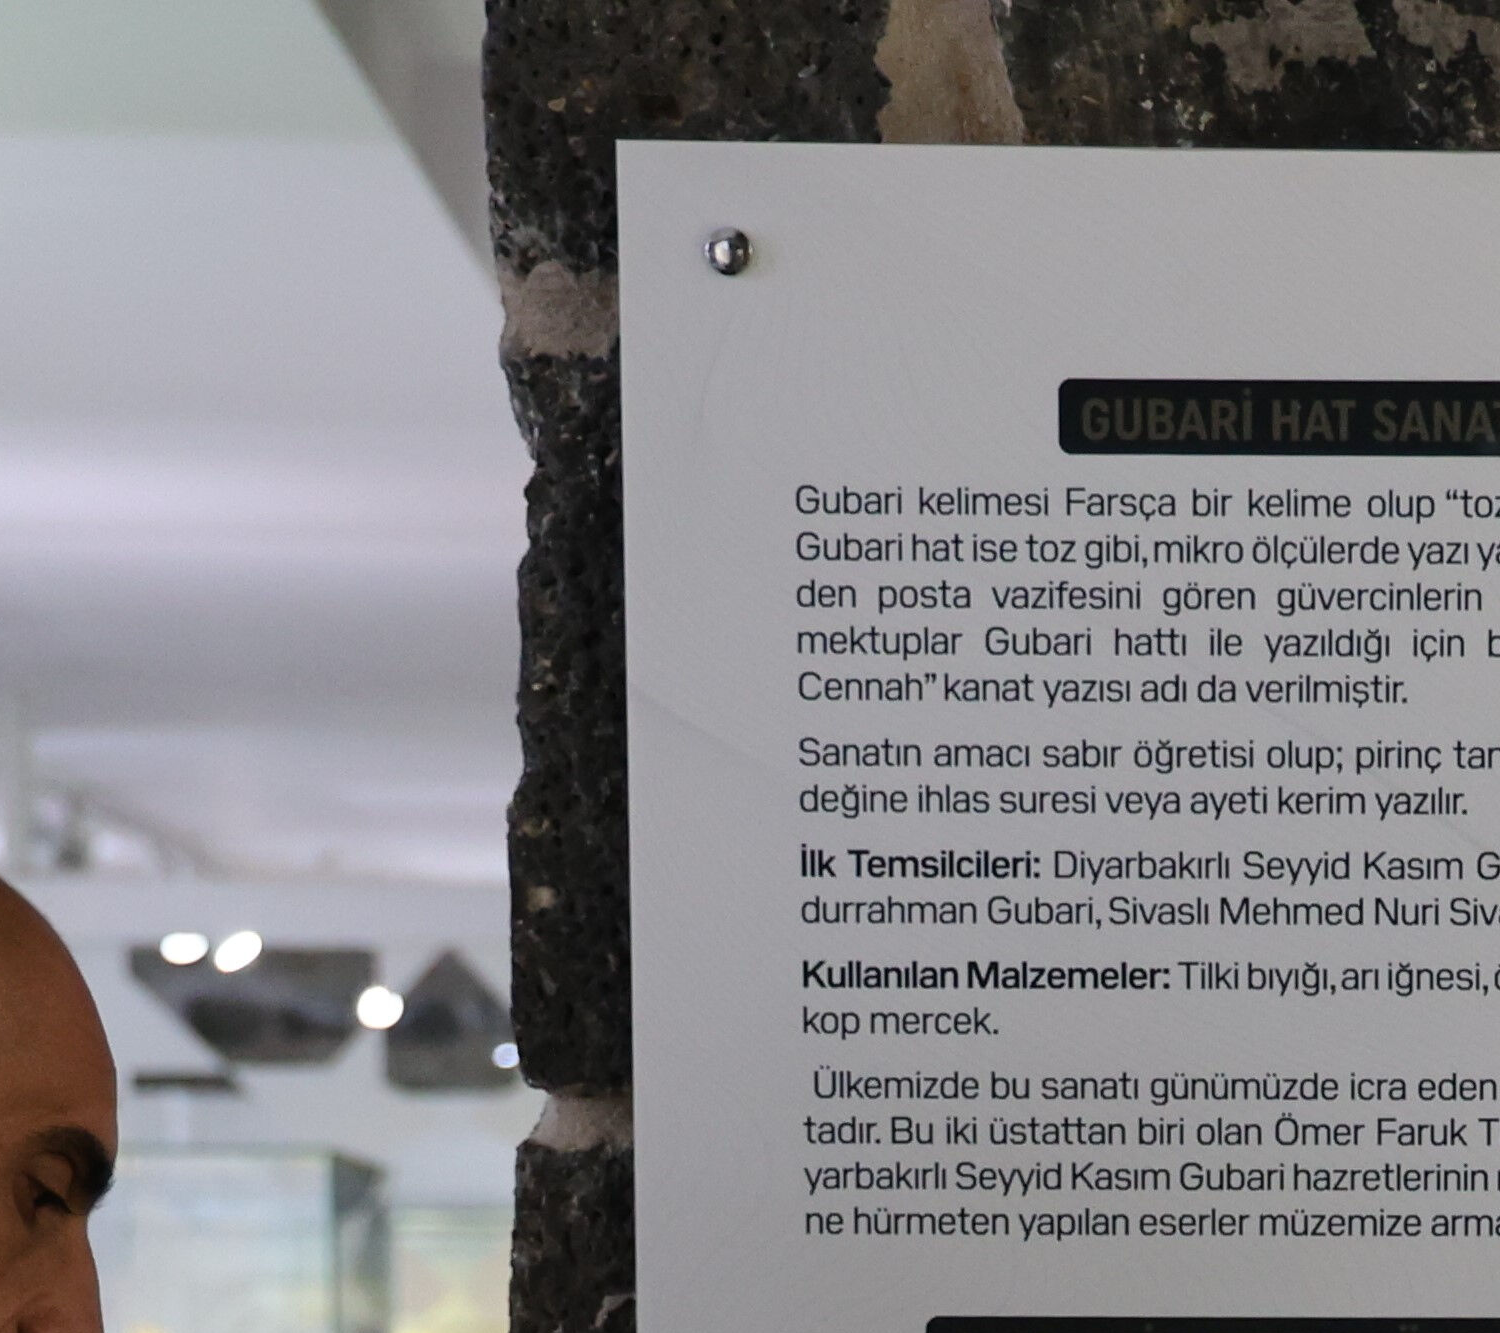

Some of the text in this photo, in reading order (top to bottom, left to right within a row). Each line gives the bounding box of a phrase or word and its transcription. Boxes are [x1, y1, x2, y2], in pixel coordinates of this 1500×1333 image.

[1079, 387, 1254, 442] GUBARİ
[1270, 398, 1358, 443] HAT
[795, 484, 903, 516] Gubari
[918, 485, 1050, 517] kelimesi
[1065, 486, 1177, 523] Farsça
[1191, 487, 1234, 518] bir
[1247, 487, 1352, 519] kelime
[1366, 488, 1436, 525] olup
[795, 530, 904, 563] Gubari
[911, 532, 965, 564] hat
[972, 532, 1019, 564] ise
[1024, 533, 1078, 564] toz
[1083, 533, 1149, 571] gibi,
[1153, 534, 1245, 565] mikro
[1251, 533, 1401, 570] ölçülerde
[1406, 541, 1470, 572] yazı
[796, 624, 964, 662] mektuplar
[984, 625, 1092, 657] Gubari
[1113, 626, 1188, 657] hattı
[1209, 627, 1244, 658] ile
[1263, 627, 1391, 665] yazıldığı
[1412, 627, 1466, 664] için
[798, 736, 923, 768] Sanatın
[933, 743, 1031, 769] amacı
[1042, 738, 1124, 769] sabır
[1133, 738, 1255, 775] öğretisi
[1266, 739, 1344, 776] olup;
[1355, 739, 1443, 777] pirinç
[800, 842, 837, 878] İlk
[846, 848, 1041, 880] Temsilcileri:
[1053, 849, 1231, 887] Diyarbakırlı
[1242, 850, 1351, 887] Seyyid
[1363, 850, 1464, 881] Kasım
[800, 894, 978, 925] durrahman
[986, 894, 1103, 931] Gubari,
[1108, 895, 1210, 926] Sivaslı
[1219, 895, 1365, 927] Mehmed
[1374, 896, 1440, 927] Nuri
[801, 959, 960, 990] Kullanılan
[966, 960, 1171, 991] Malzemeler:
[1176, 960, 1240, 991] Tilki
[1247, 961, 1337, 998] bıyığı,
[1340, 967, 1380, 991] arı
[1387, 961, 1489, 998] iğnesi,
[813, 1064, 980, 1101] Ülkemizde
[989, 1070, 1031, 1101] bu
[1040, 1071, 1140, 1101] sanatı
[1149, 1071, 1340, 1107] günümüzde
[1349, 1071, 1407, 1102] icra
[1417, 1071, 1498, 1102] eden
[802, 1115, 882, 1145] tadır.
[890, 1115, 934, 1146] Bu
[945, 1115, 978, 1146] iki
[988, 1115, 1127, 1146] üstattan
[1137, 1116, 1185, 1147] biri
[1195, 1116, 1263, 1147] olan
[1274, 1111, 1366, 1147] Ömer
[1376, 1116, 1468, 1148] Faruk
[805, 1211, 845, 1236] ne
[852, 1205, 1010, 1236] hürmeten
[1017, 1207, 1130, 1243] yapılan
[1138, 1207, 1251, 1237] eserler
[1258, 1207, 1423, 1238] müzemize
